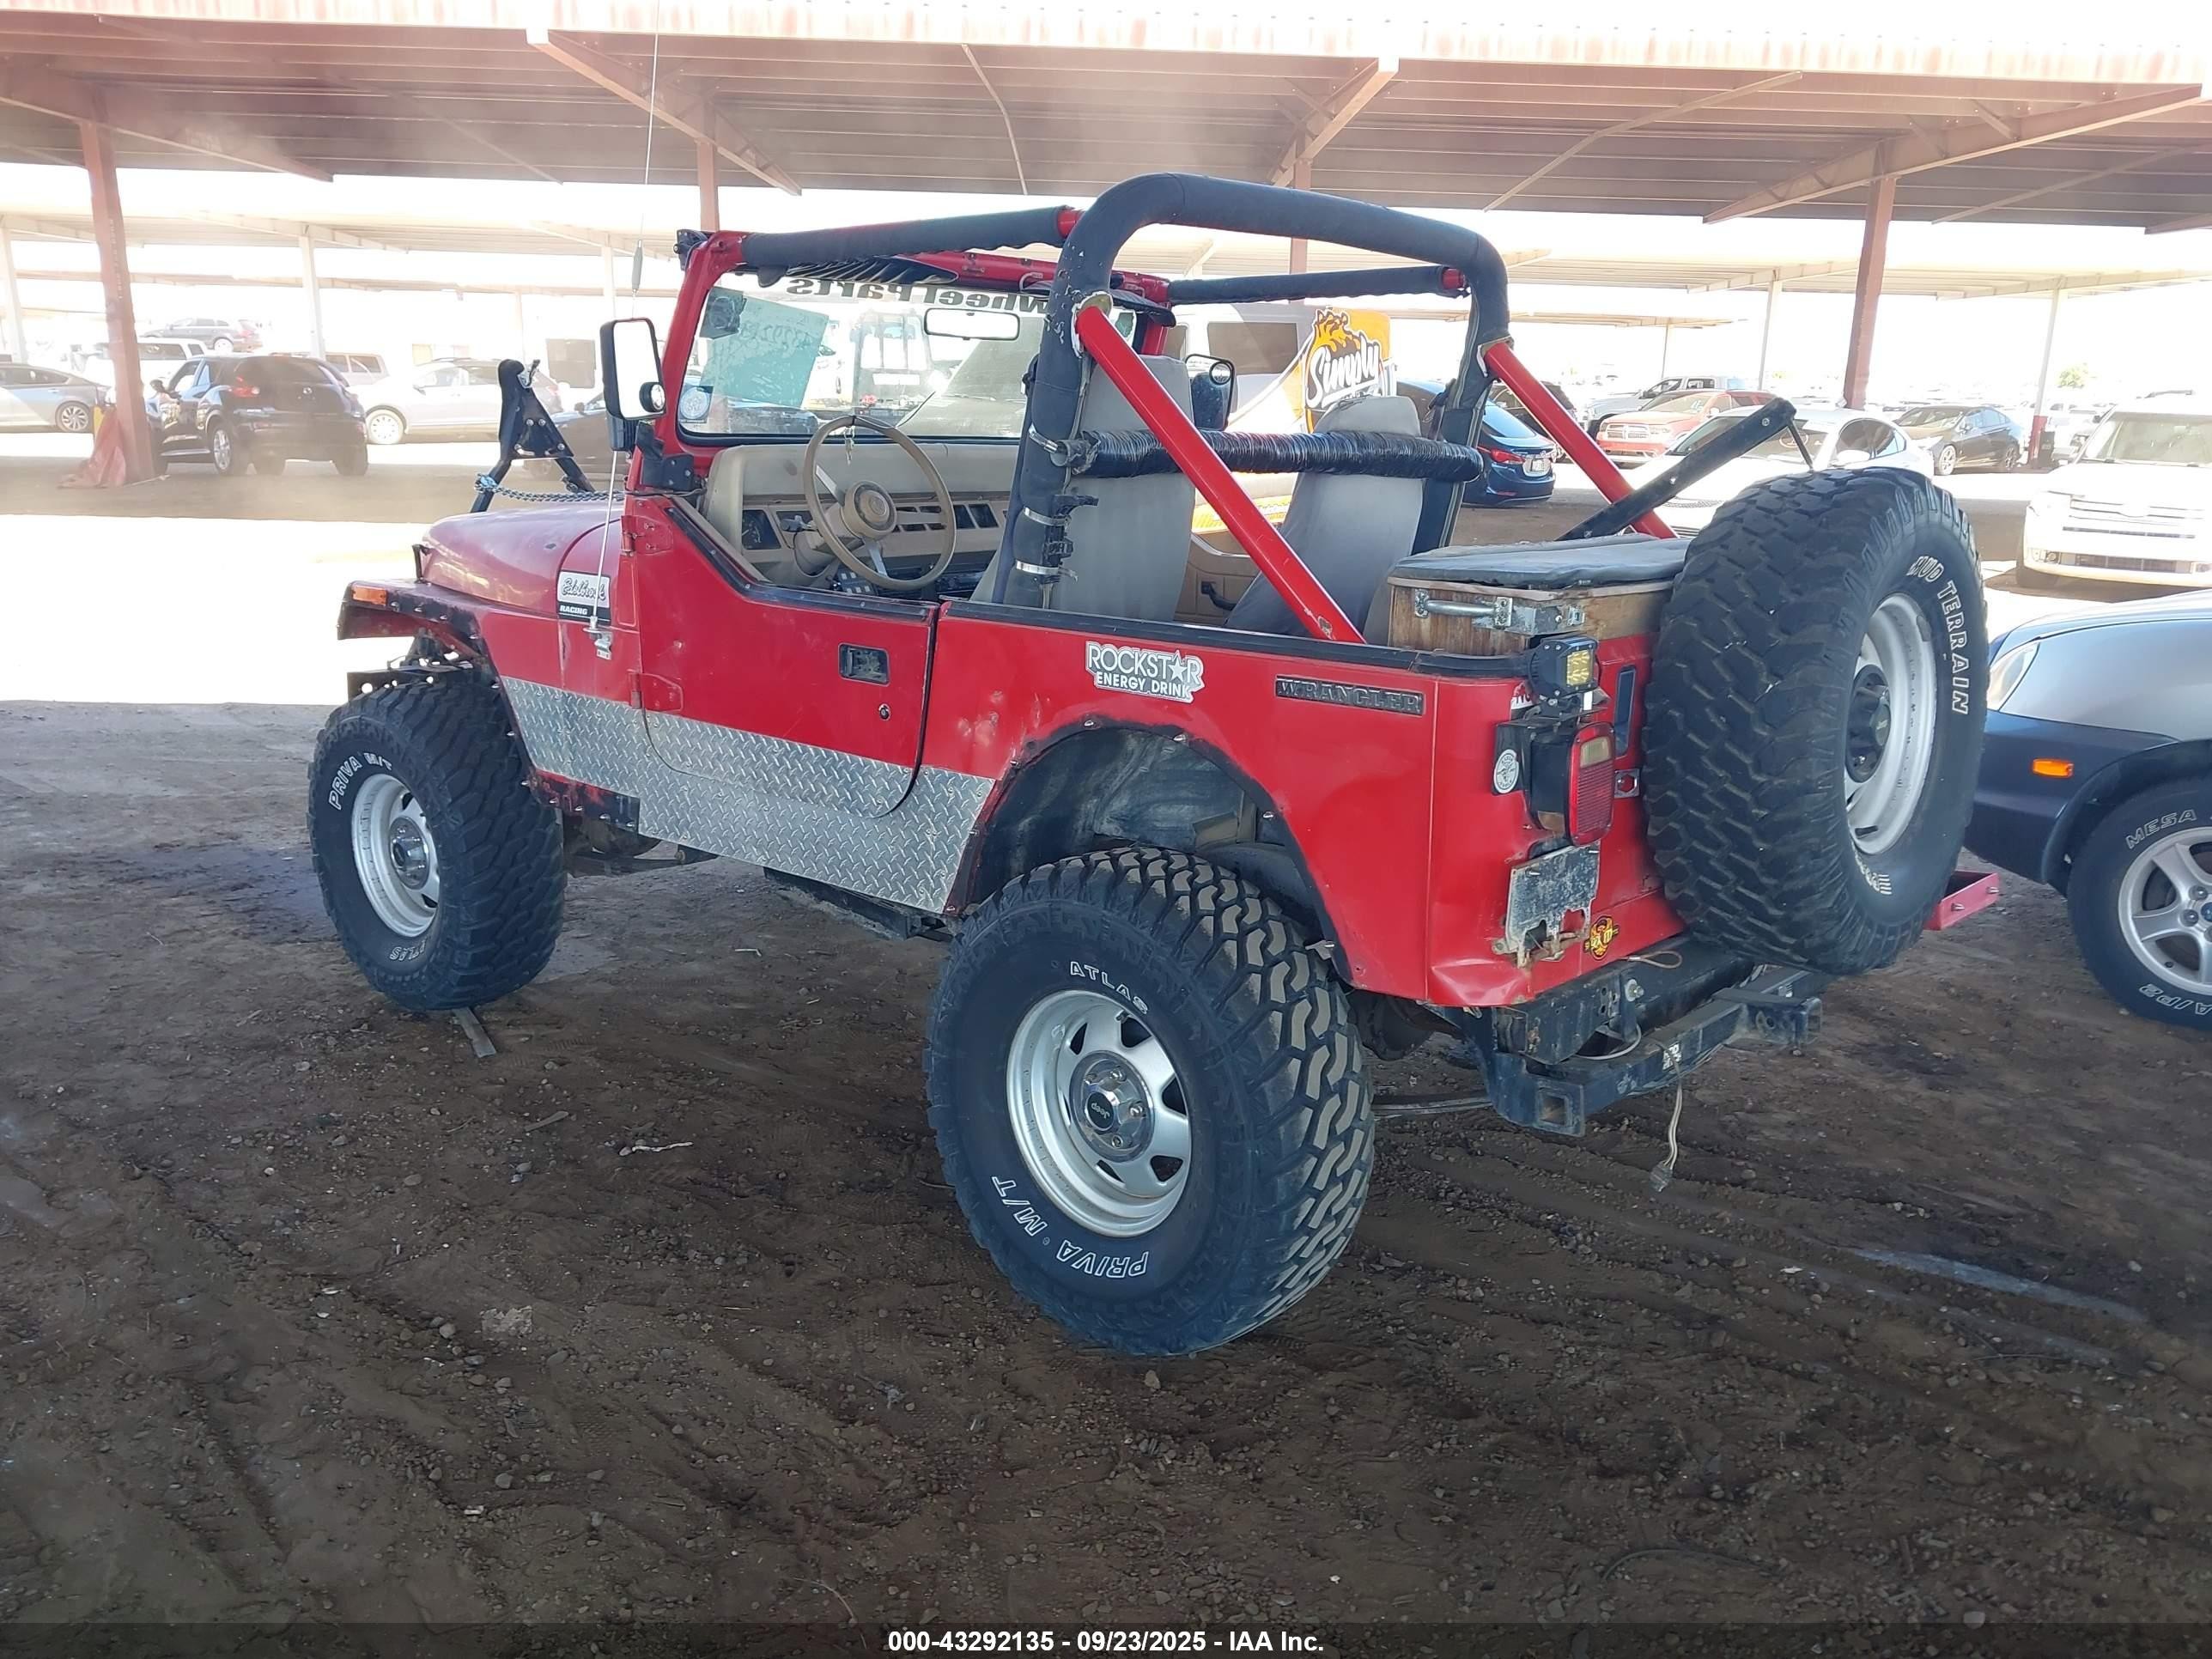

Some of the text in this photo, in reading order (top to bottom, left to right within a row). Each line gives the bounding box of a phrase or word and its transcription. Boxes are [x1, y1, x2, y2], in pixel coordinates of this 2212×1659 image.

[1305, 331, 1380, 409] Simply
[559, 605, 588, 616] RACING
[1936, 580, 1971, 714] TERRAIN
[1097, 671, 1192, 698] ENERGY DRINK
[1279, 678, 1421, 714] WRANGLER
[328, 756, 362, 811] PRIVA
[2125, 808, 2197, 850] MESA
[1070, 961, 1149, 1015] ATLAS
[991, 1176, 1150, 1279] PRIVA M/T
